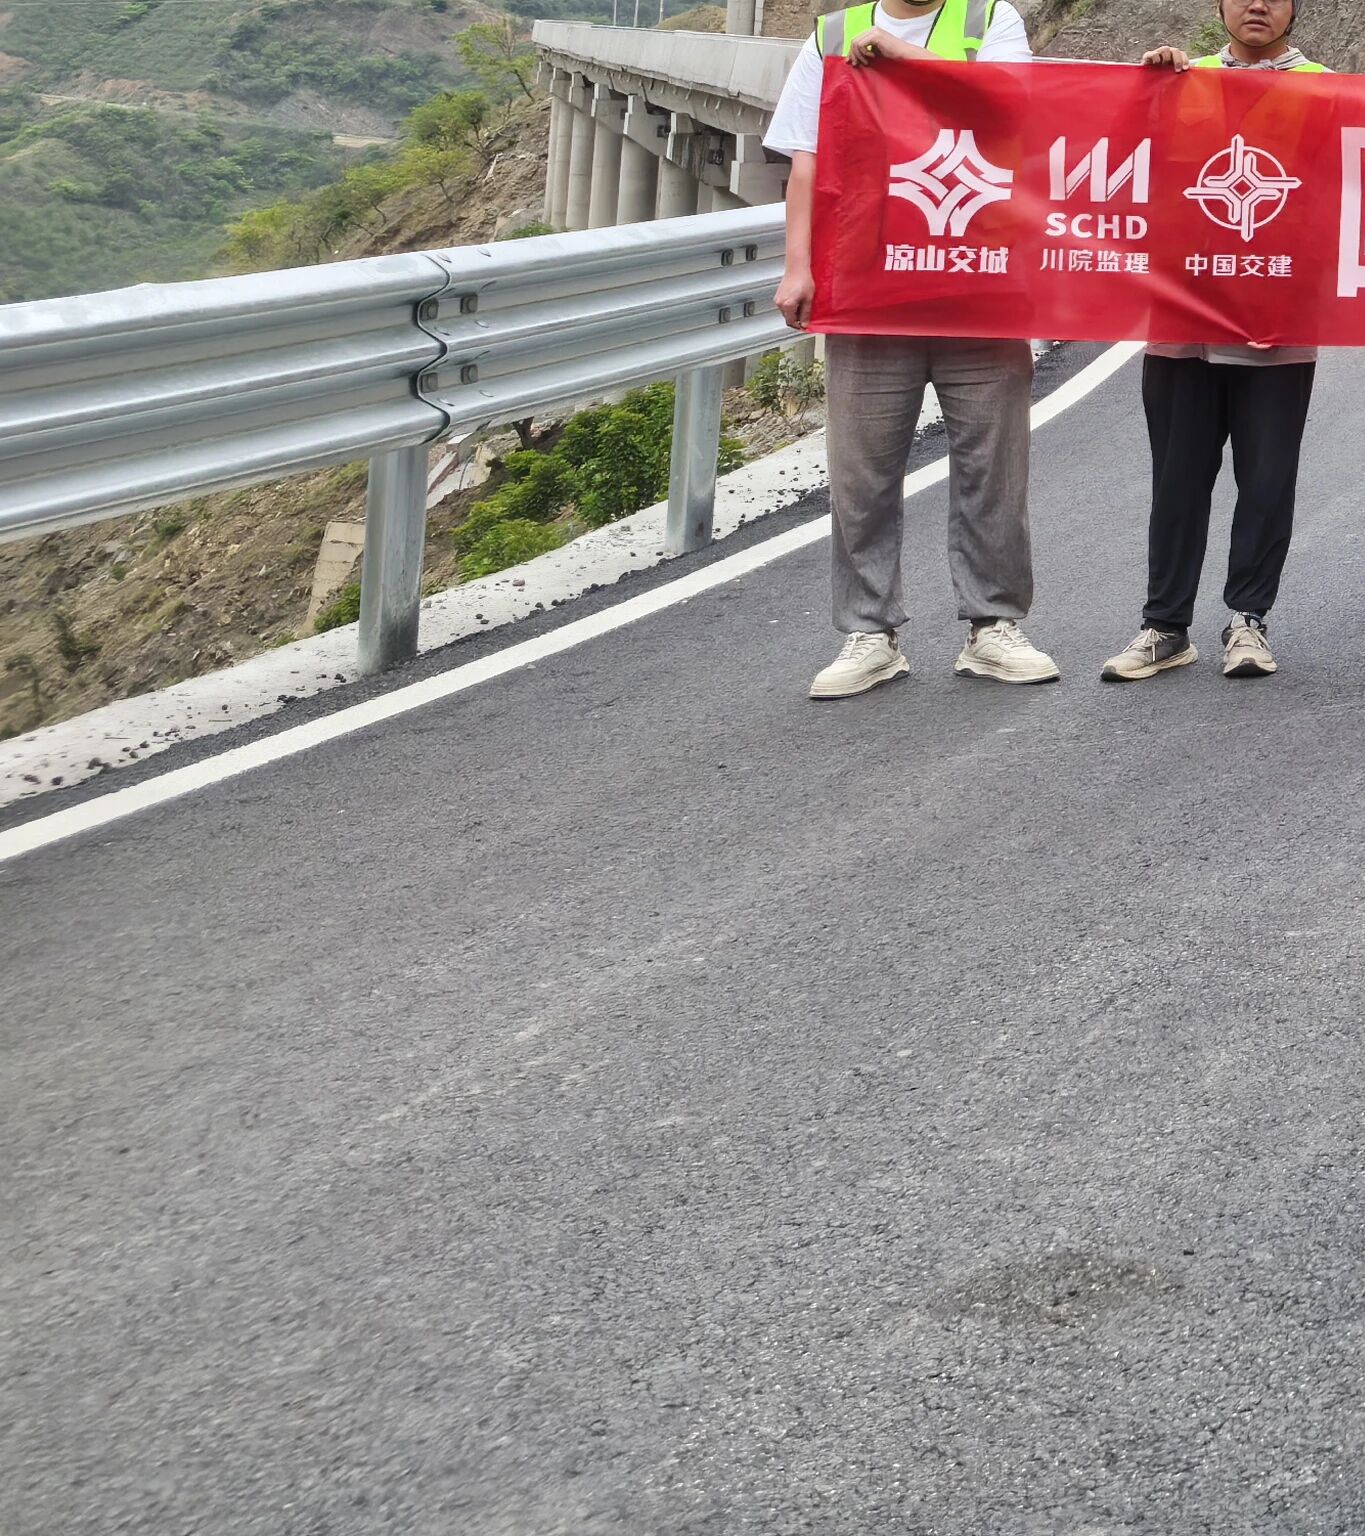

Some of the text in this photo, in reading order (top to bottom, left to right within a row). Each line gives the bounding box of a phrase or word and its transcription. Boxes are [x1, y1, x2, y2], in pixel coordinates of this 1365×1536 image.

[1045, 213, 1147, 240] SCHD
[885, 244, 1009, 274] 凉山交城
[1040, 248, 1150, 275] 川院监理
[1185, 254, 1293, 278] 中国交建
